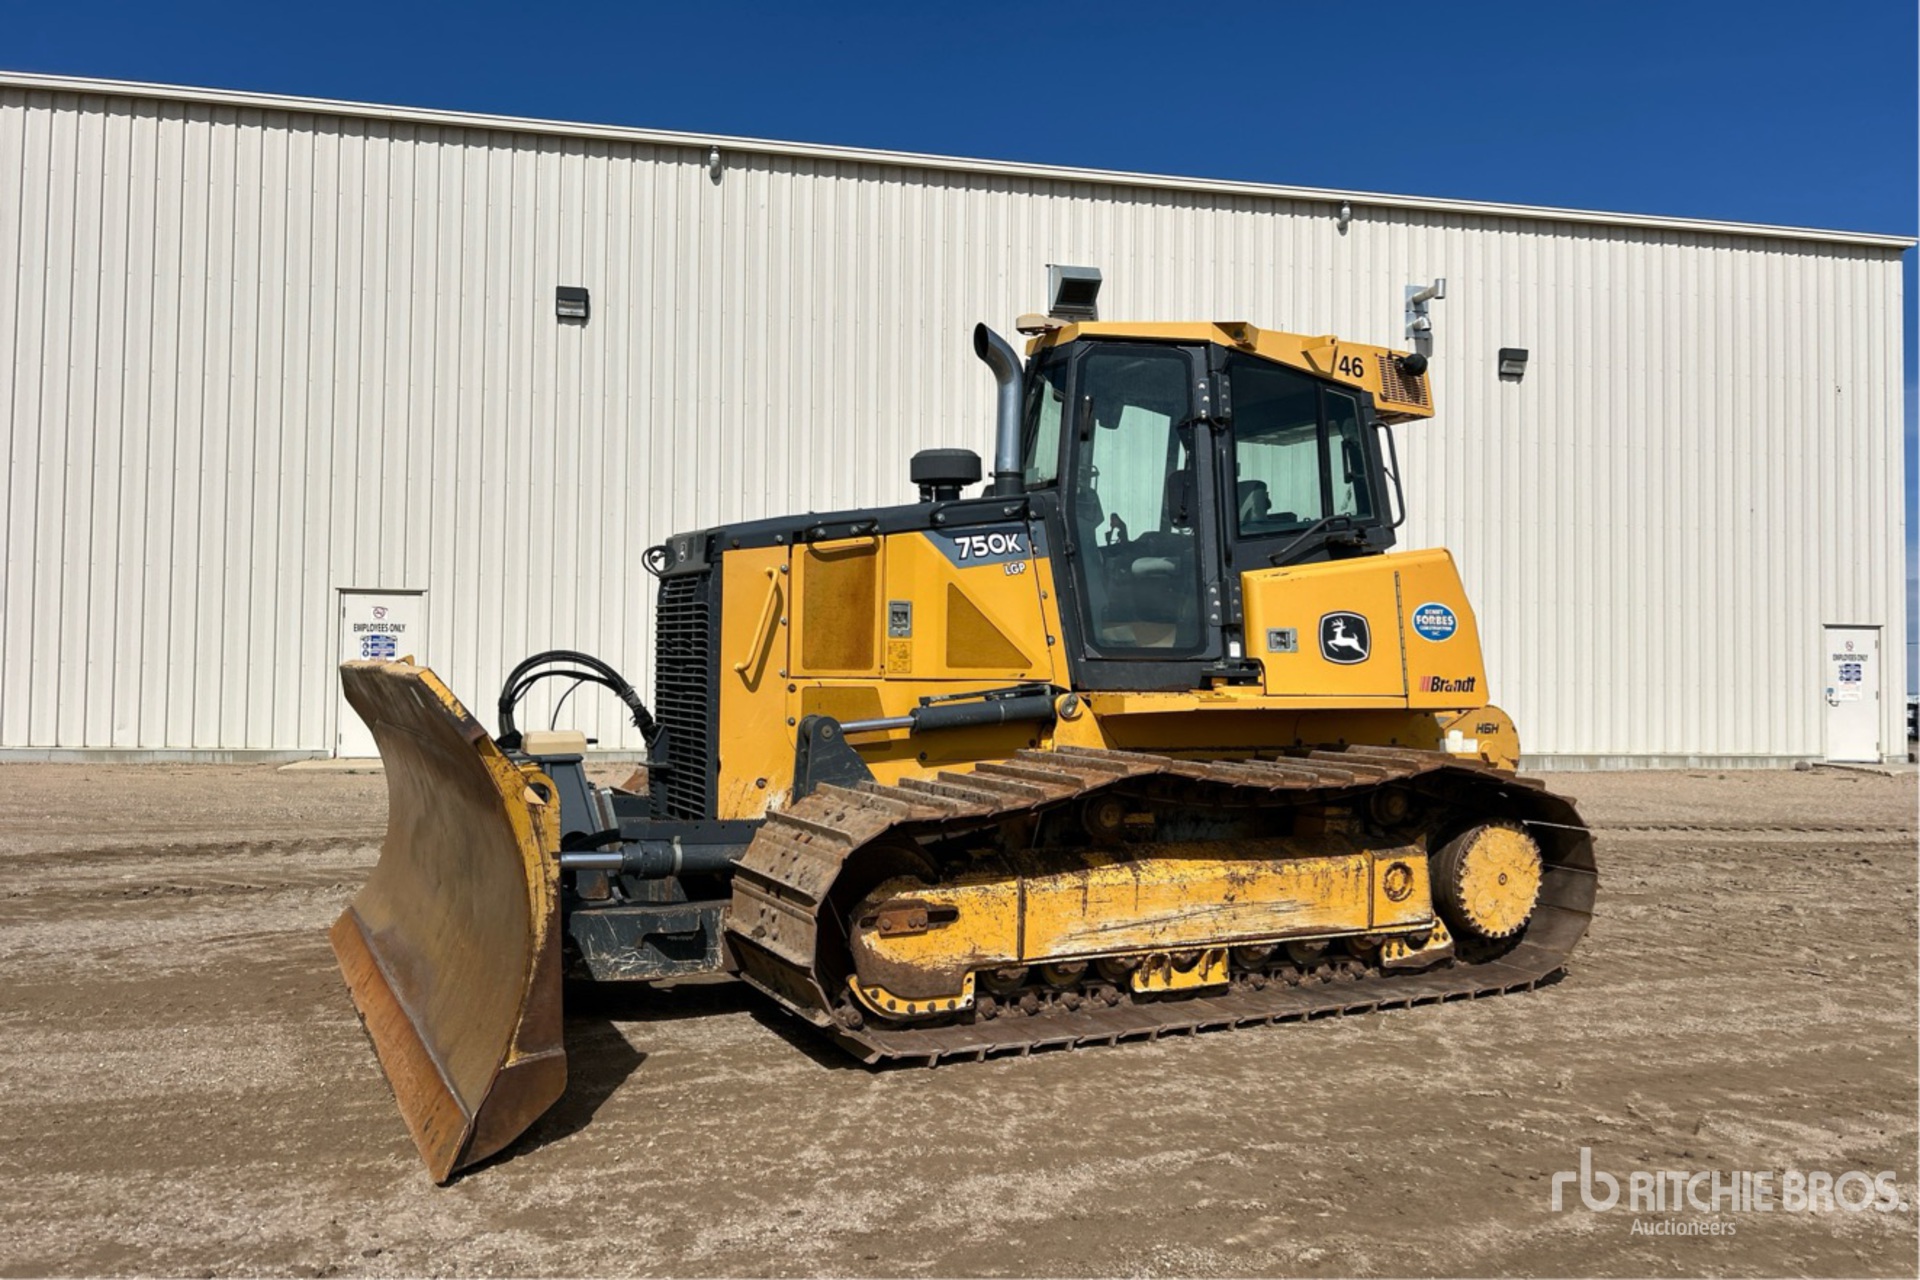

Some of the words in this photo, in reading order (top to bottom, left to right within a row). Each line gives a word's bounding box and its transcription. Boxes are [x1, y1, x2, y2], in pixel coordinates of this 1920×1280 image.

[1339, 355, 1364, 378] 46
[954, 533, 1023, 560] 750K
[1003, 562, 1026, 576] LGP
[353, 623, 389, 632] EMPLOYEES
[390, 623, 406, 632] ONLY
[1415, 614, 1454, 626] FORBES
[1431, 676, 1475, 692] Brandt
